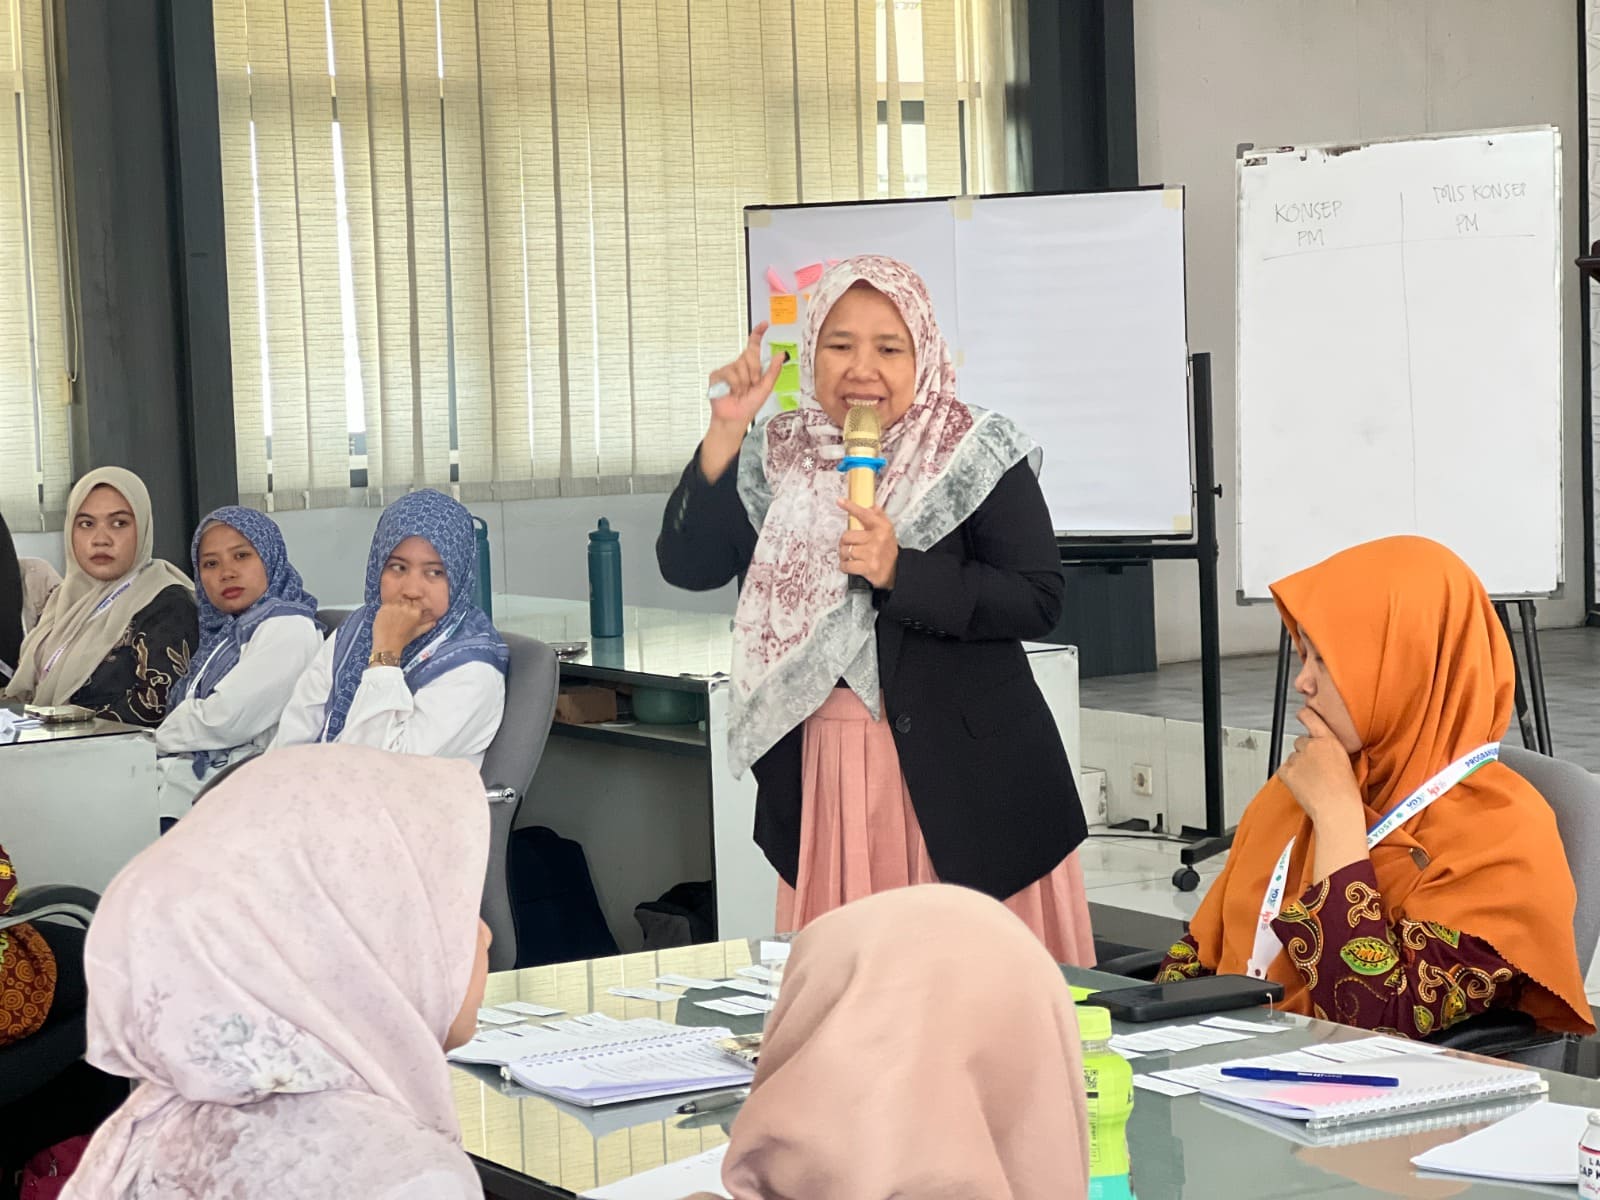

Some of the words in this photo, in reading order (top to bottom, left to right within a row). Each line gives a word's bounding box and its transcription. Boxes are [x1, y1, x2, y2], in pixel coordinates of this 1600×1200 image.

[1275, 200, 1343, 224] KONSEP
[1456, 212, 1479, 234] PM
[1297, 228, 1325, 247] PM
